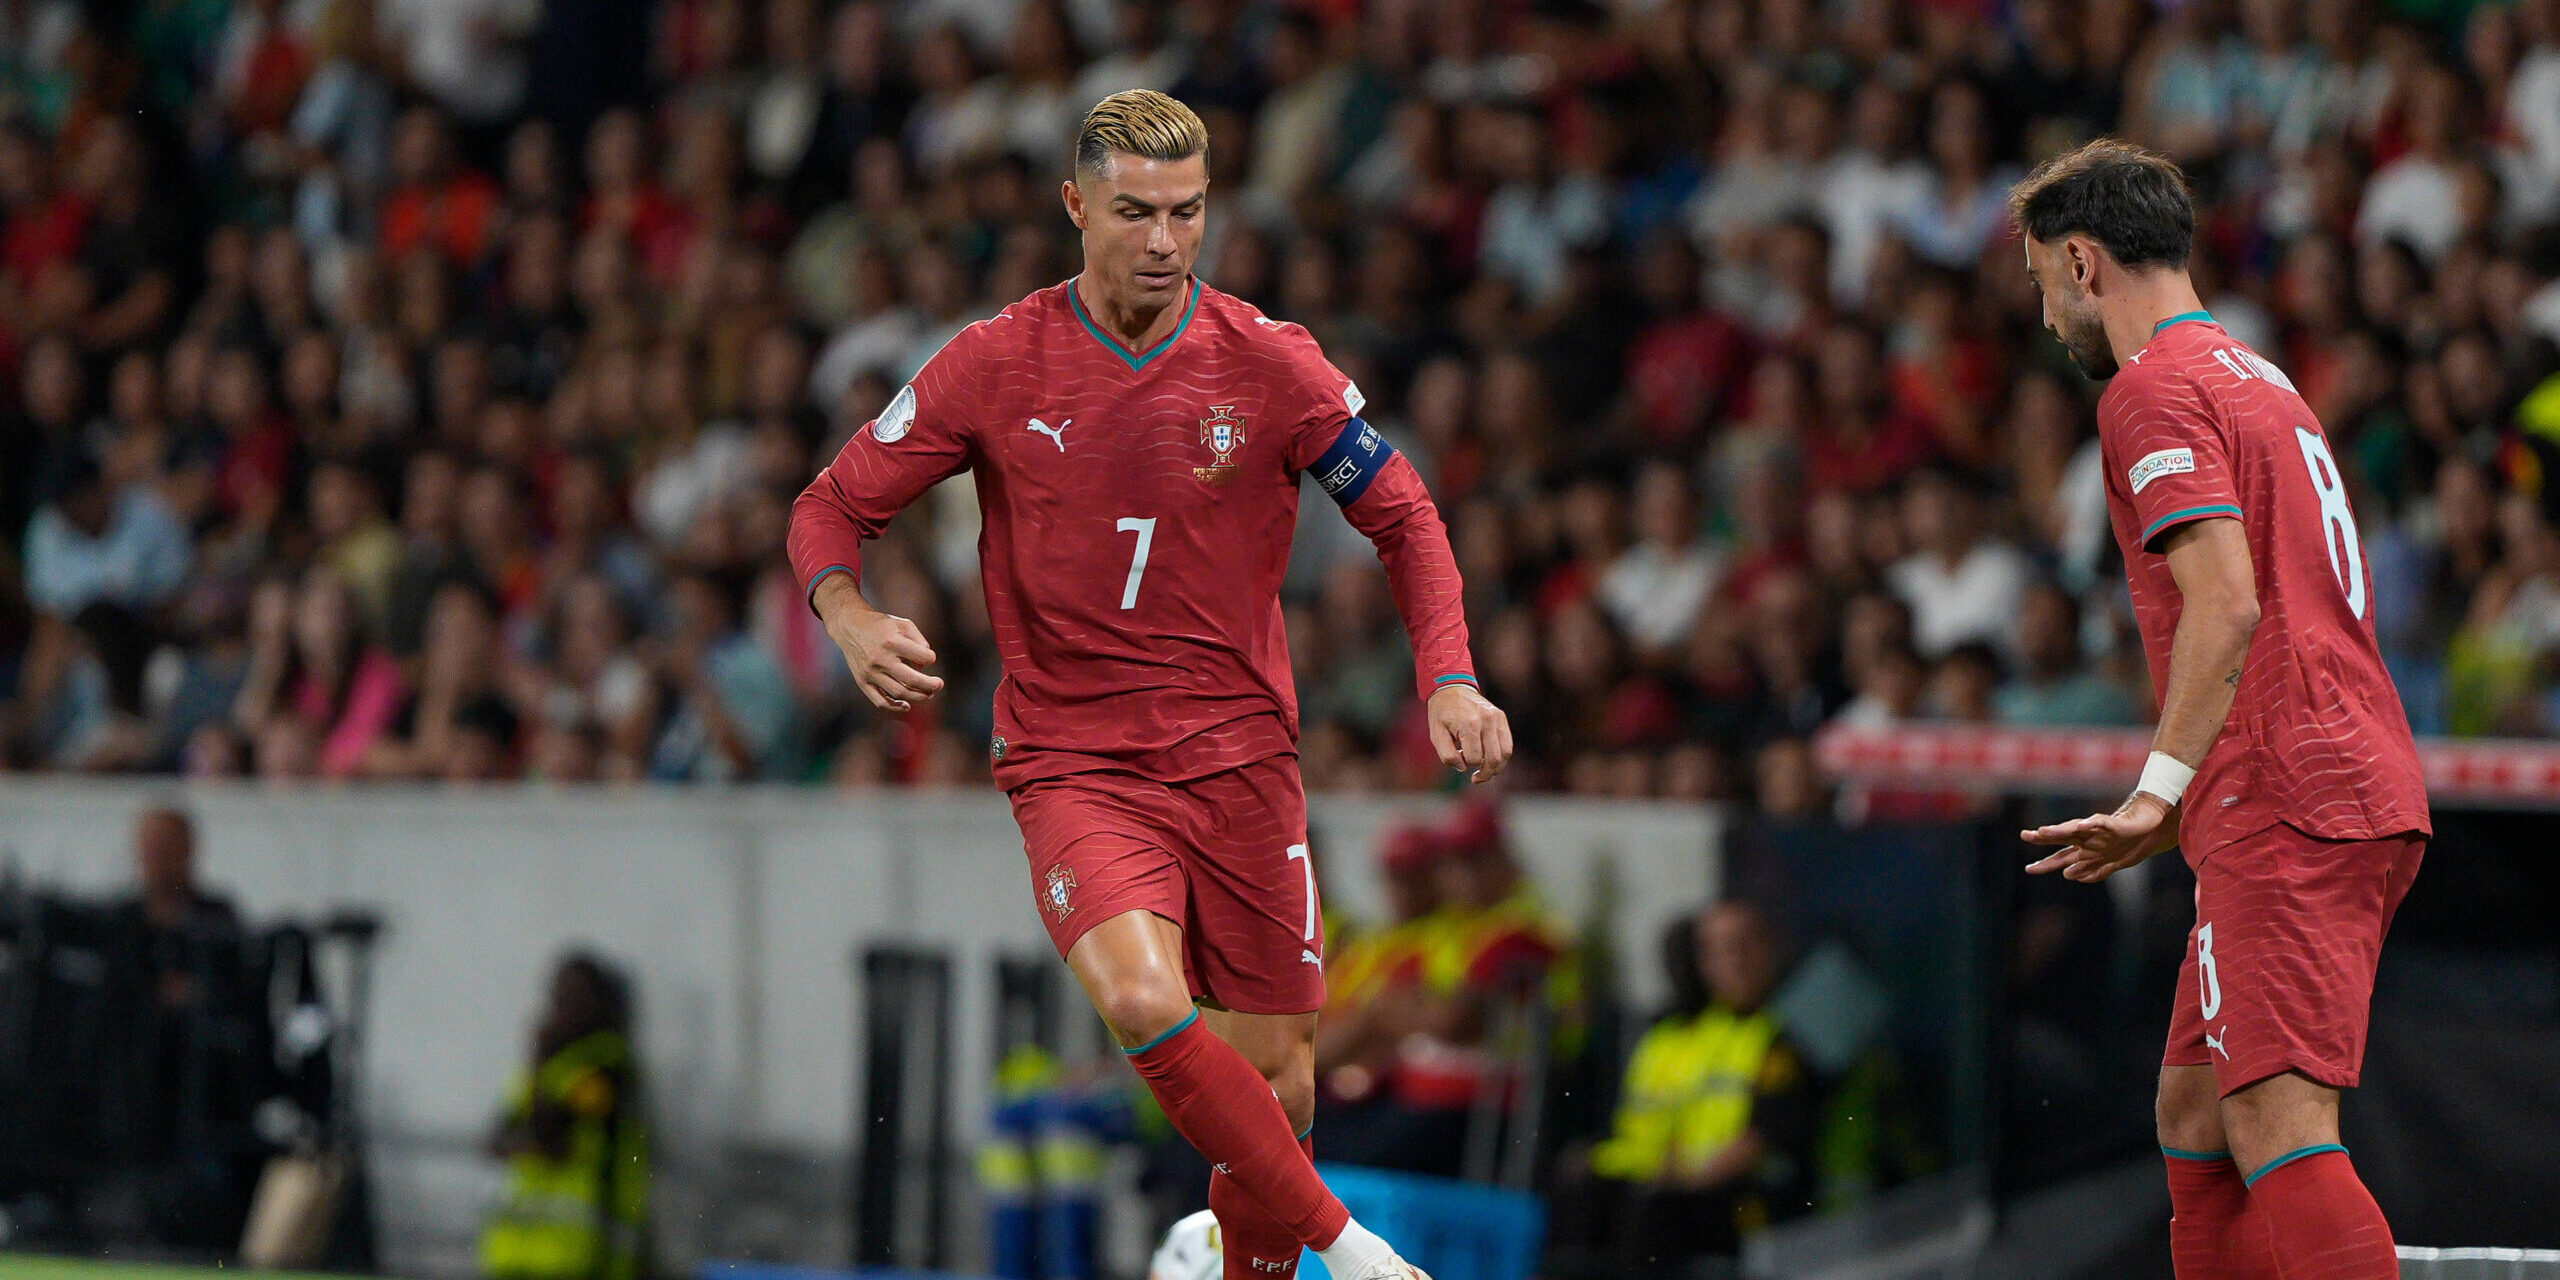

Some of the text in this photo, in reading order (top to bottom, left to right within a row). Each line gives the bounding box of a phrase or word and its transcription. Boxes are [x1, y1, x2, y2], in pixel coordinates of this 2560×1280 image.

[2131, 455, 2192, 485] FOUNDATION
[1116, 517, 1157, 610] 7
[2295, 425, 2366, 621] 8
[1286, 842, 1315, 941] 7
